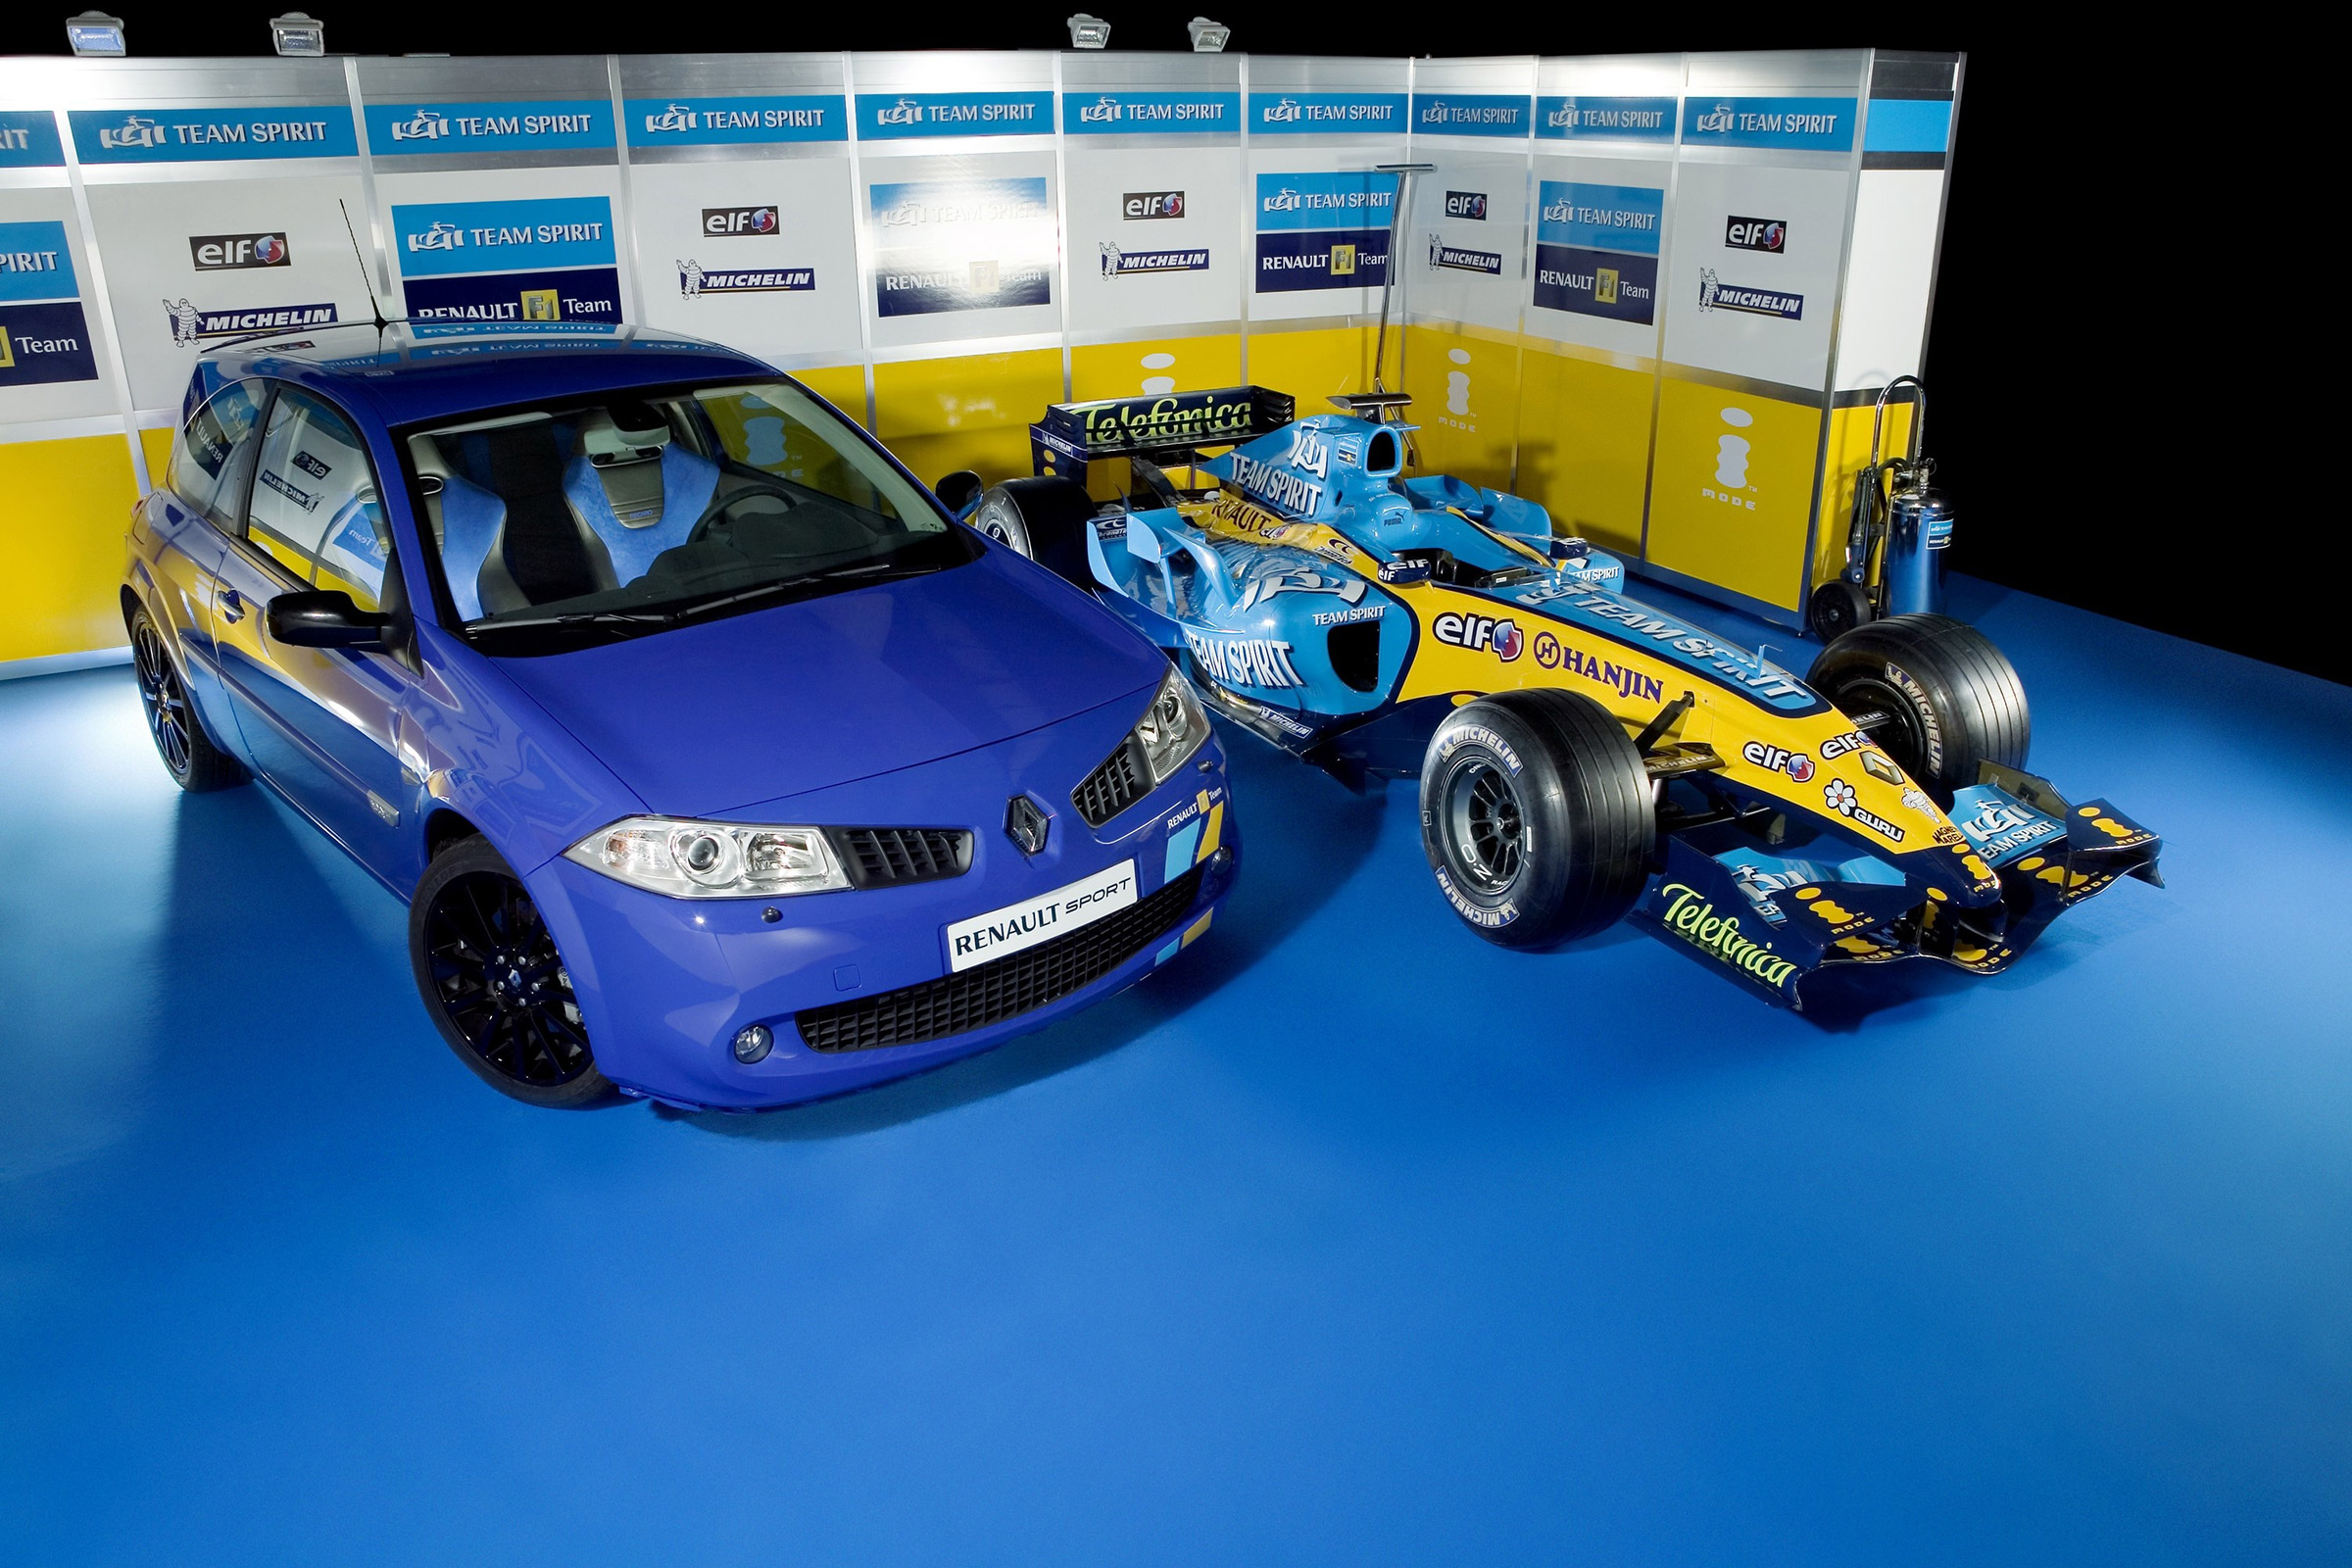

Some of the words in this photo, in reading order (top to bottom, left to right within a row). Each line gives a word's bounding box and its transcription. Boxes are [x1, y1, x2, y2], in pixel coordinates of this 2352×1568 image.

[703, 111, 760, 129] TEAM
[764, 110, 824, 127] SPIRIT
[928, 106, 978, 122] TEAM
[982, 104, 1035, 121] SPIRIT
[1127, 104, 1172, 120] TEAM
[1175, 103, 1224, 120] SPIRIT
[1305, 105, 1348, 121] TEAM
[1349, 105, 1393, 120] SPIRIT
[1451, 107, 1481, 123] TEAM
[1483, 108, 1518, 124] SPIRIT
[1583, 110, 1620, 127] TEAM
[1622, 111, 1663, 129] SPIRIT
[172, 123, 245, 144] TEAM
[252, 122, 327, 143] SPIRIT
[456, 117, 519, 136] TEAM
[524, 115, 591, 134] SPIRIT
[1740, 113, 1781, 132] TEAM
[1785, 114, 1838, 134] SPIRIT
[1126, 195, 1162, 217] elf
[1305, 194, 1348, 210] TEAM
[1348, 192, 1392, 208] SPIRIT
[1446, 196, 1471, 216] elf
[706, 211, 750, 233] elf
[1578, 209, 1612, 226] TEAM
[1614, 212, 1655, 230] SPIRIT
[469, 226, 532, 246] TEAM
[538, 223, 603, 244] SPIRIT
[1728, 222, 1763, 245] elf
[0, 251, 58, 272] PIRIT
[197, 239, 251, 265] elf
[1123, 253, 1206, 269] MICHELIN
[1262, 254, 1329, 270] RENAULT
[1357, 253, 1388, 266] Team
[1443, 251, 1499, 270] MICHELIN
[706, 272, 810, 288] MICHELIN
[1540, 270, 1594, 291] RENAULT
[1620, 281, 1648, 299] Team
[564, 298, 612, 315] Team
[1719, 289, 1800, 313] MICHELIN
[206, 308, 332, 331] MICHELIN
[16, 336, 78, 355] Team
[1229, 452, 1271, 495] TEAM
[1267, 468, 1322, 516] SPIRIT
[1378, 569, 1396, 581] elf
[1387, 559, 1430, 570] elf
[1592, 565, 1620, 581] SPIRIT
[1312, 612, 1349, 626] TEAM
[1349, 606, 1386, 620] SPIRIT
[1575, 596, 1688, 641] TEAM
[1436, 614, 1494, 650] elf
[1185, 628, 1230, 682] TEAM
[1228, 640, 1303, 687] SPIRIT
[1562, 646, 1664, 705] HANJIN
[1902, 679, 1942, 777] MICHELIN
[1452, 726, 1522, 771] MICHELIN
[1743, 742, 1788, 770] elf
[1822, 732, 1860, 759] elf
[1167, 802, 1198, 829] RENAULT
[1207, 787, 1223, 801] Team
[1977, 837, 2013, 859] EAM
[2011, 820, 2057, 844] SPIRIT
[1436, 871, 1500, 927] MICHELIN
[955, 904, 1060, 956] RENAULT
[1065, 877, 1132, 914] SPORT
